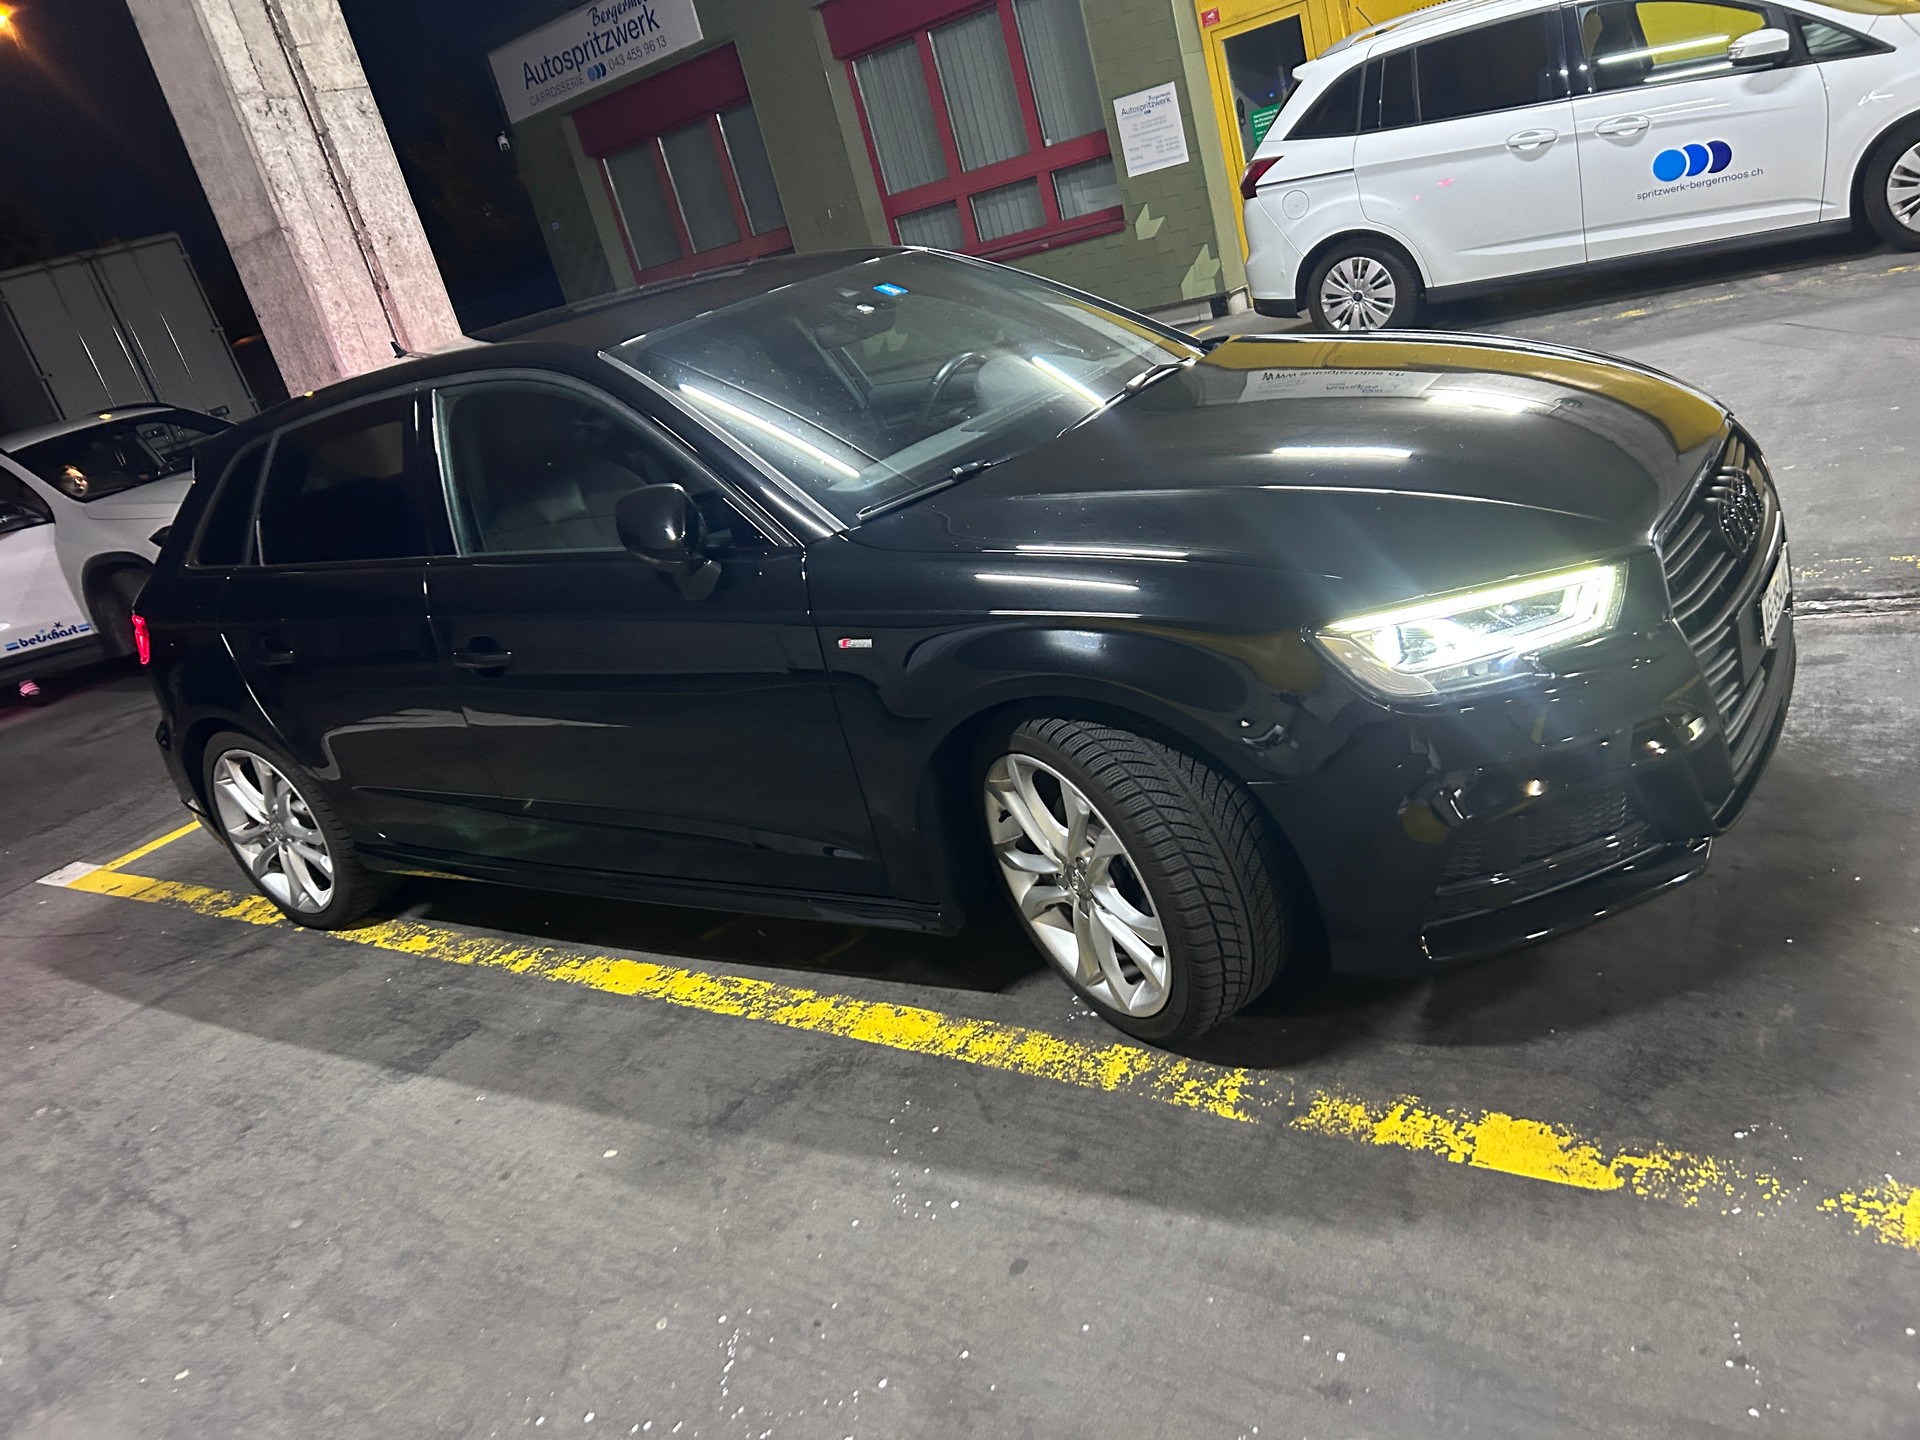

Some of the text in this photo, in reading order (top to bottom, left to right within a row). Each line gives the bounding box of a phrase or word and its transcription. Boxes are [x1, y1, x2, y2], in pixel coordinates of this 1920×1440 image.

[523, 4, 661, 90] Autospritzwerk
[529, 35, 667, 107] CARROSSERIE 043 455 96 13
[1636, 167, 1764, 200] spritzwerk-bergermoos.ch
